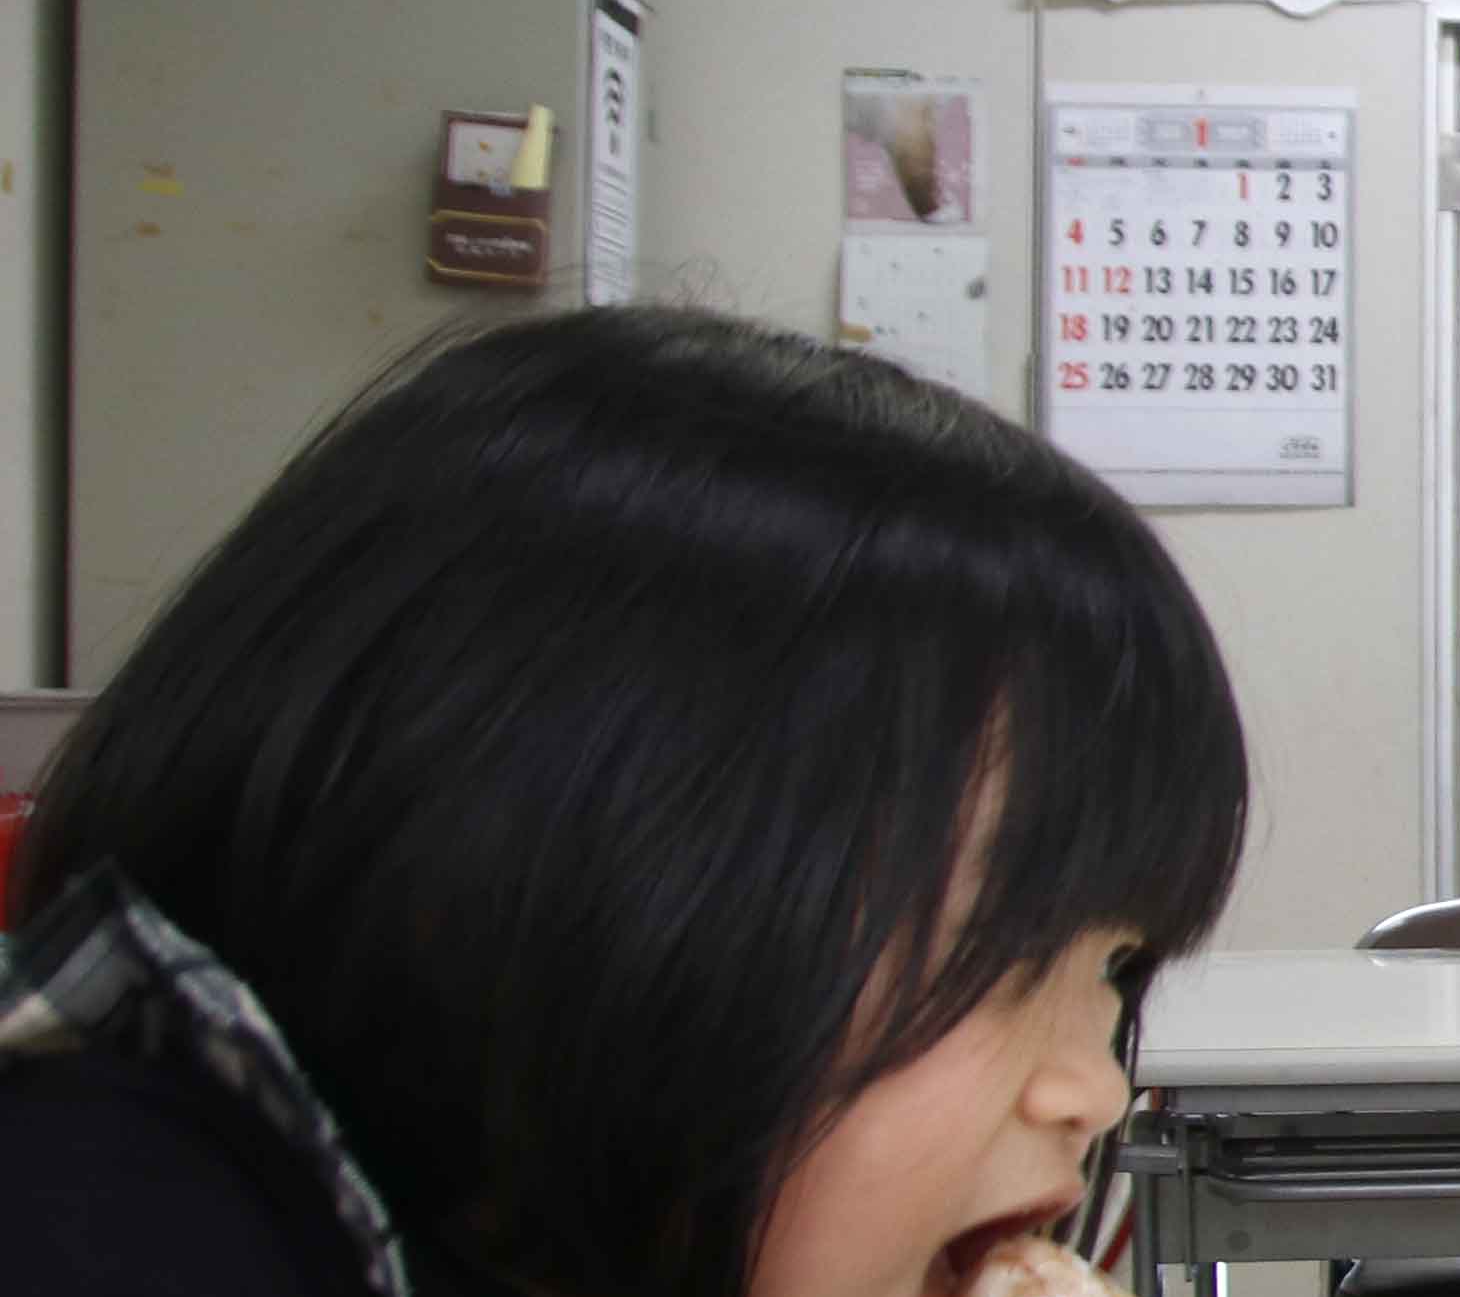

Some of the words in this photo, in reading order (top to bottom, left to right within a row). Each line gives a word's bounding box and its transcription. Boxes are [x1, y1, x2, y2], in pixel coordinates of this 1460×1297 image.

[1194, 119, 1208, 149] 1
[1238, 174, 1248, 199] 1
[1277, 175, 1292, 200] 2
[1317, 174, 1332, 200] 3
[1067, 221, 1083, 245] 4
[1109, 220, 1124, 246] 5
[1150, 220, 1166, 246] 6
[1192, 221, 1206, 246] 7
[1234, 221, 1249, 247] 8
[1275, 222, 1290, 247] 9
[1312, 222, 1337, 248] 10
[1062, 266, 1088, 293] 11
[1104, 267, 1131, 293] 12
[1145, 268, 1172, 294] 13
[1187, 268, 1213, 294] 14
[1229, 269, 1254, 295] 15
[1270, 269, 1296, 295] 16
[1312, 270, 1336, 296] 17
[1061, 315, 1087, 341] 18
[1103, 315, 1129, 342] 19
[1142, 315, 1173, 342] 20
[1186, 316, 1215, 342] 21
[1227, 316, 1257, 343] 22
[1268, 316, 1298, 343] 23
[1309, 317, 1339, 344] 24
[1060, 364, 1089, 390] 25
[1100, 364, 1130, 390] 26
[1142, 364, 1172, 390] 27
[1185, 364, 1214, 391] 28
[1226, 364, 1256, 391] 29
[1267, 365, 1298, 392] 30
[1312, 365, 1337, 392] 31
